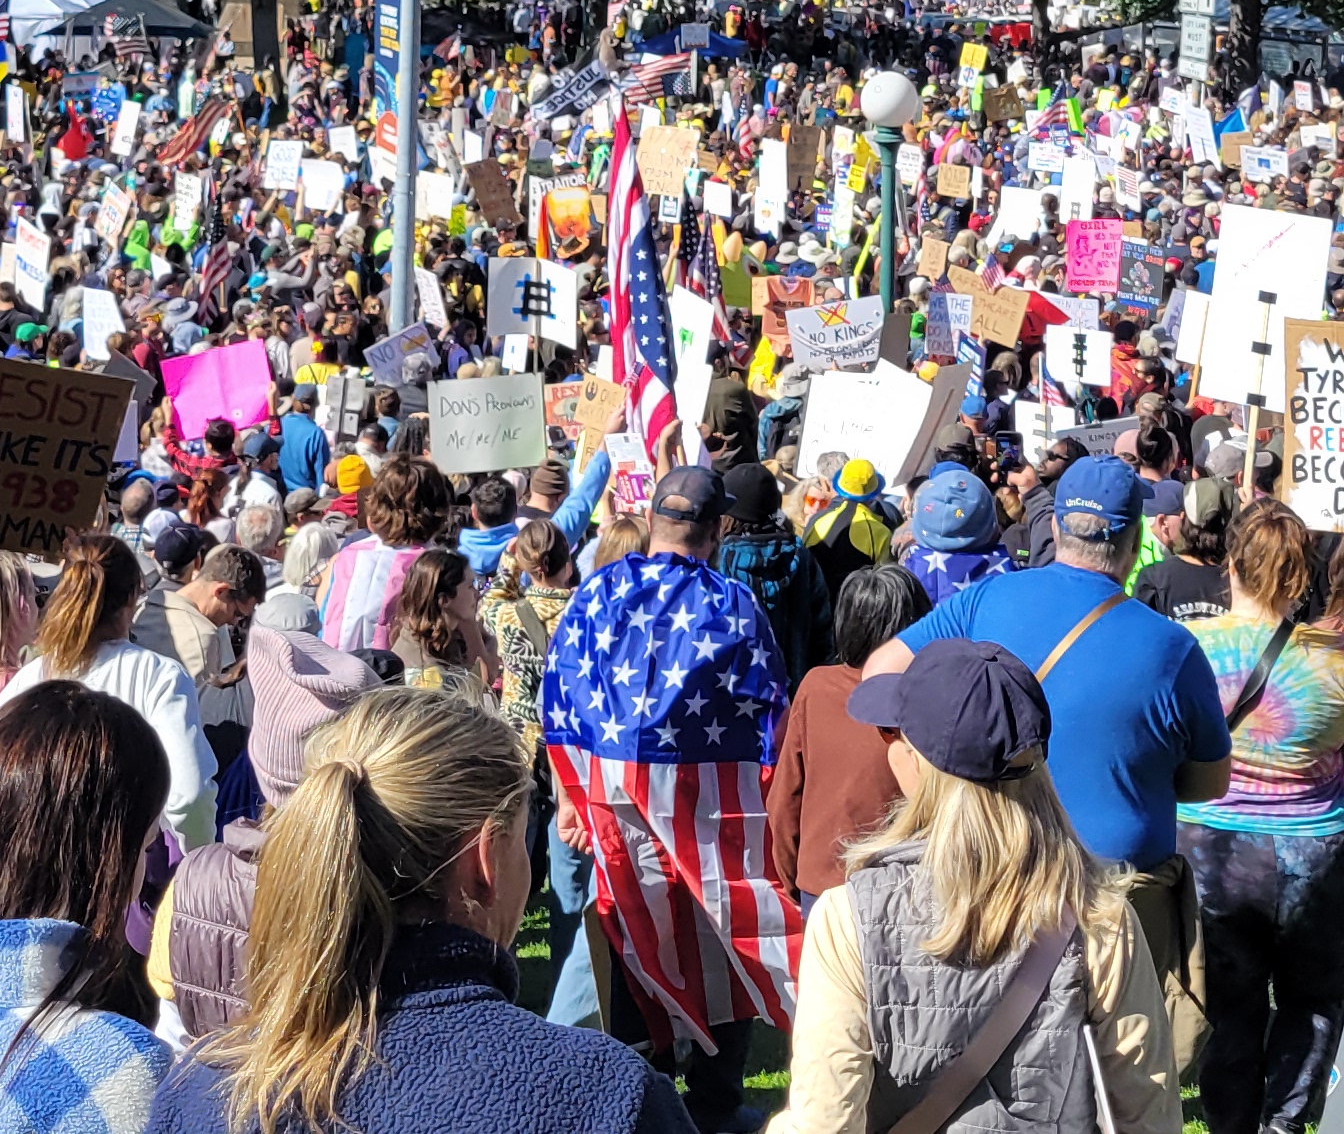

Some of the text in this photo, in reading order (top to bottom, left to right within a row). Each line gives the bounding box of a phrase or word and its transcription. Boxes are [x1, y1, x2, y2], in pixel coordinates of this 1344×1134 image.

[1188, 32, 1202, 42] MUST
[541, 174, 586, 193] TRAITOR
[1081, 222, 1107, 230] GIRL
[931, 297, 970, 311] WE THE
[809, 321, 875, 345] NO KINGS
[975, 314, 1002, 335] ALL
[370, 344, 395, 368] NO
[54, 438, 110, 477] IT'S
[1066, 497, 1103, 511] UnCruise
